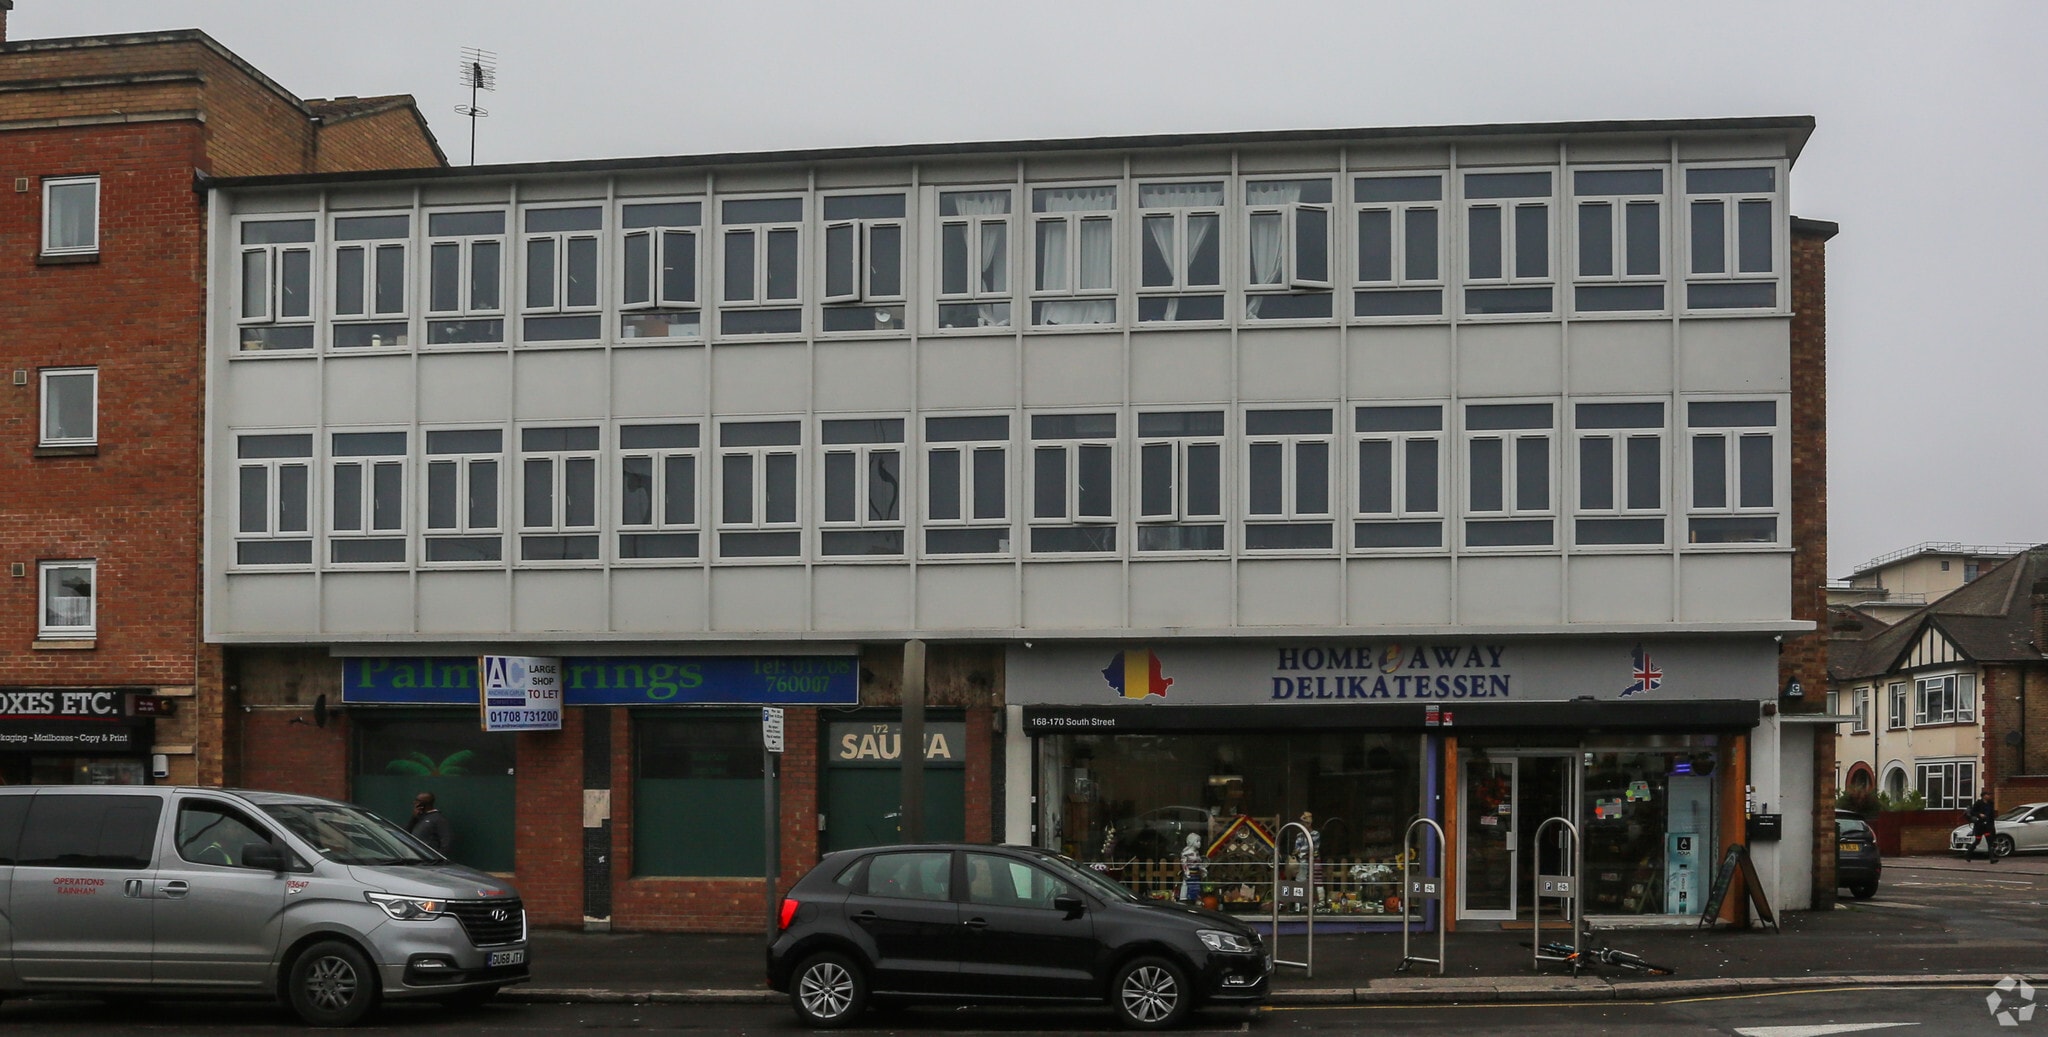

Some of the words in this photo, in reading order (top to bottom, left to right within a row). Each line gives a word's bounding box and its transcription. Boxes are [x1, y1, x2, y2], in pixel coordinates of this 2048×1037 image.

[1278, 647, 1372, 669] HOME
[1408, 646, 1505, 669] AWAY
[487, 657, 526, 689] AC
[529, 665, 556, 674] LARGE
[357, 657, 479, 689] Palm
[561, 658, 704, 700] rings
[532, 677, 554, 685] SHOP
[1272, 674, 1510, 699] DELIKATESSEN
[528, 690, 540, 699] TO
[543, 690, 559, 699] LET
[61, 692, 118, 714] ETC.
[491, 711, 521, 722] 01708
[524, 711, 558, 722] 731200
[1032, 718, 1064, 726] 168-170
[1066, 718, 1089, 726] South
[1091, 718, 1115, 726] Street
[872, 724, 889, 733] 172
[79, 734, 100, 743] Copy
[102, 734, 108, 742] &
[109, 733, 128, 742] Print
[840, 733, 951, 760] SAUA
[53, 877, 105, 886] OPERATIONS
[57, 886, 97, 895] RAINHAM
[493, 953, 510, 965] DU68
